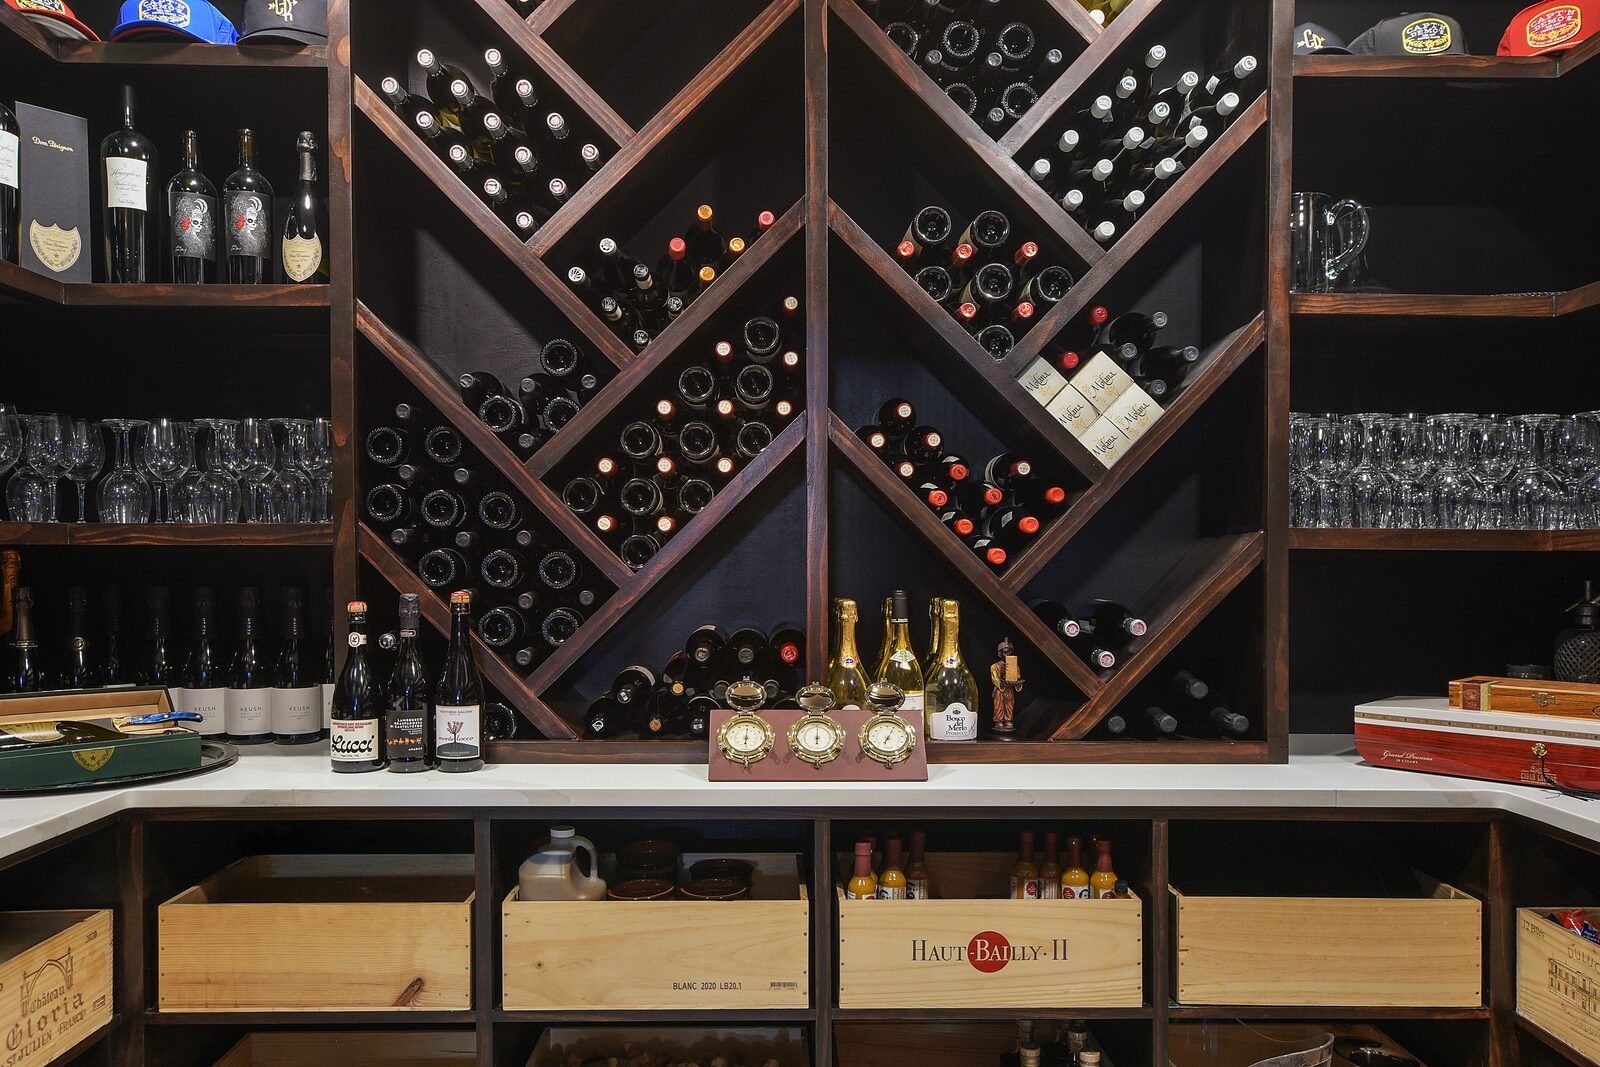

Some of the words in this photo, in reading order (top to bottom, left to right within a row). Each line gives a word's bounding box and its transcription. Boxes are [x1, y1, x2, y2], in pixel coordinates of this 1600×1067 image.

[331, 734, 375, 754] Lucci
[672, 982, 697, 990] BLANC
[700, 982, 717, 990] 2020
[719, 982, 742, 990] LB20.1
[29, 984, 65, 1014] Château
[6, 992, 85, 1052] Gloria
